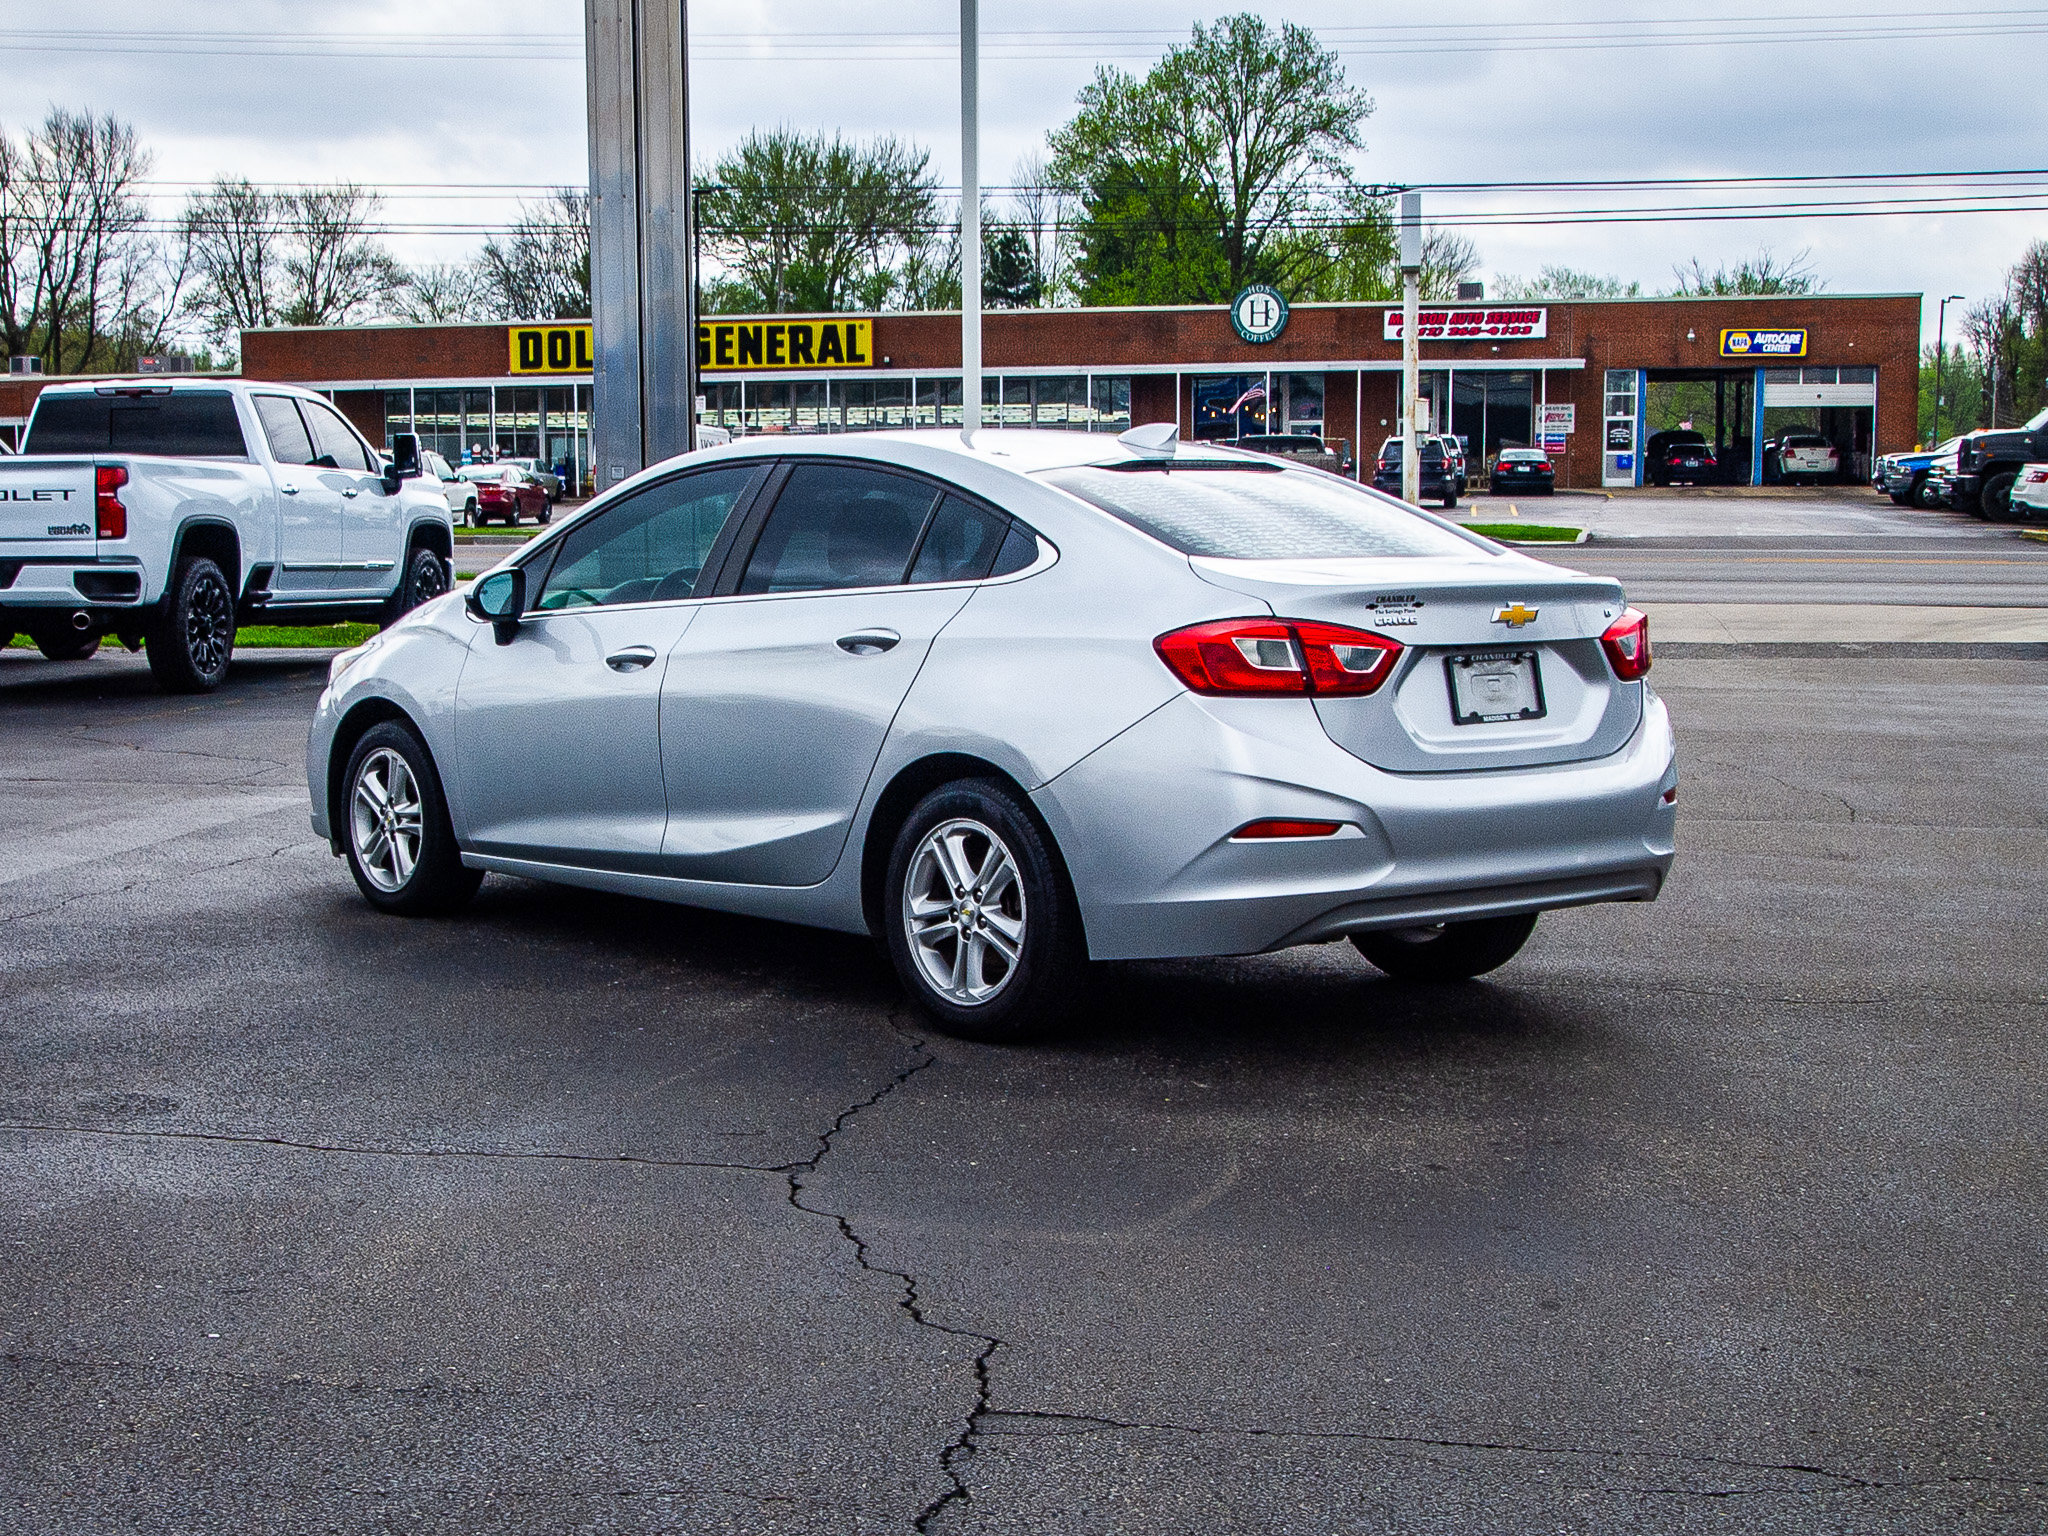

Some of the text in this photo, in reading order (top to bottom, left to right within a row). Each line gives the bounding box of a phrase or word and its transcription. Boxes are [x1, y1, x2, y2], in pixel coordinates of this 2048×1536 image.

[1247, 284, 1271, 295] HOS
[1449, 311, 1485, 325] AUTO
[1485, 311, 1542, 324] SERVICE
[1240, 329, 1278, 343] COFFEE
[1732, 337, 1749, 347] NAPA
[1762, 344, 1792, 353] CENTER
[1374, 616, 1418, 627] CRUZE
[1470, 651, 1518, 661] CHANDLER
